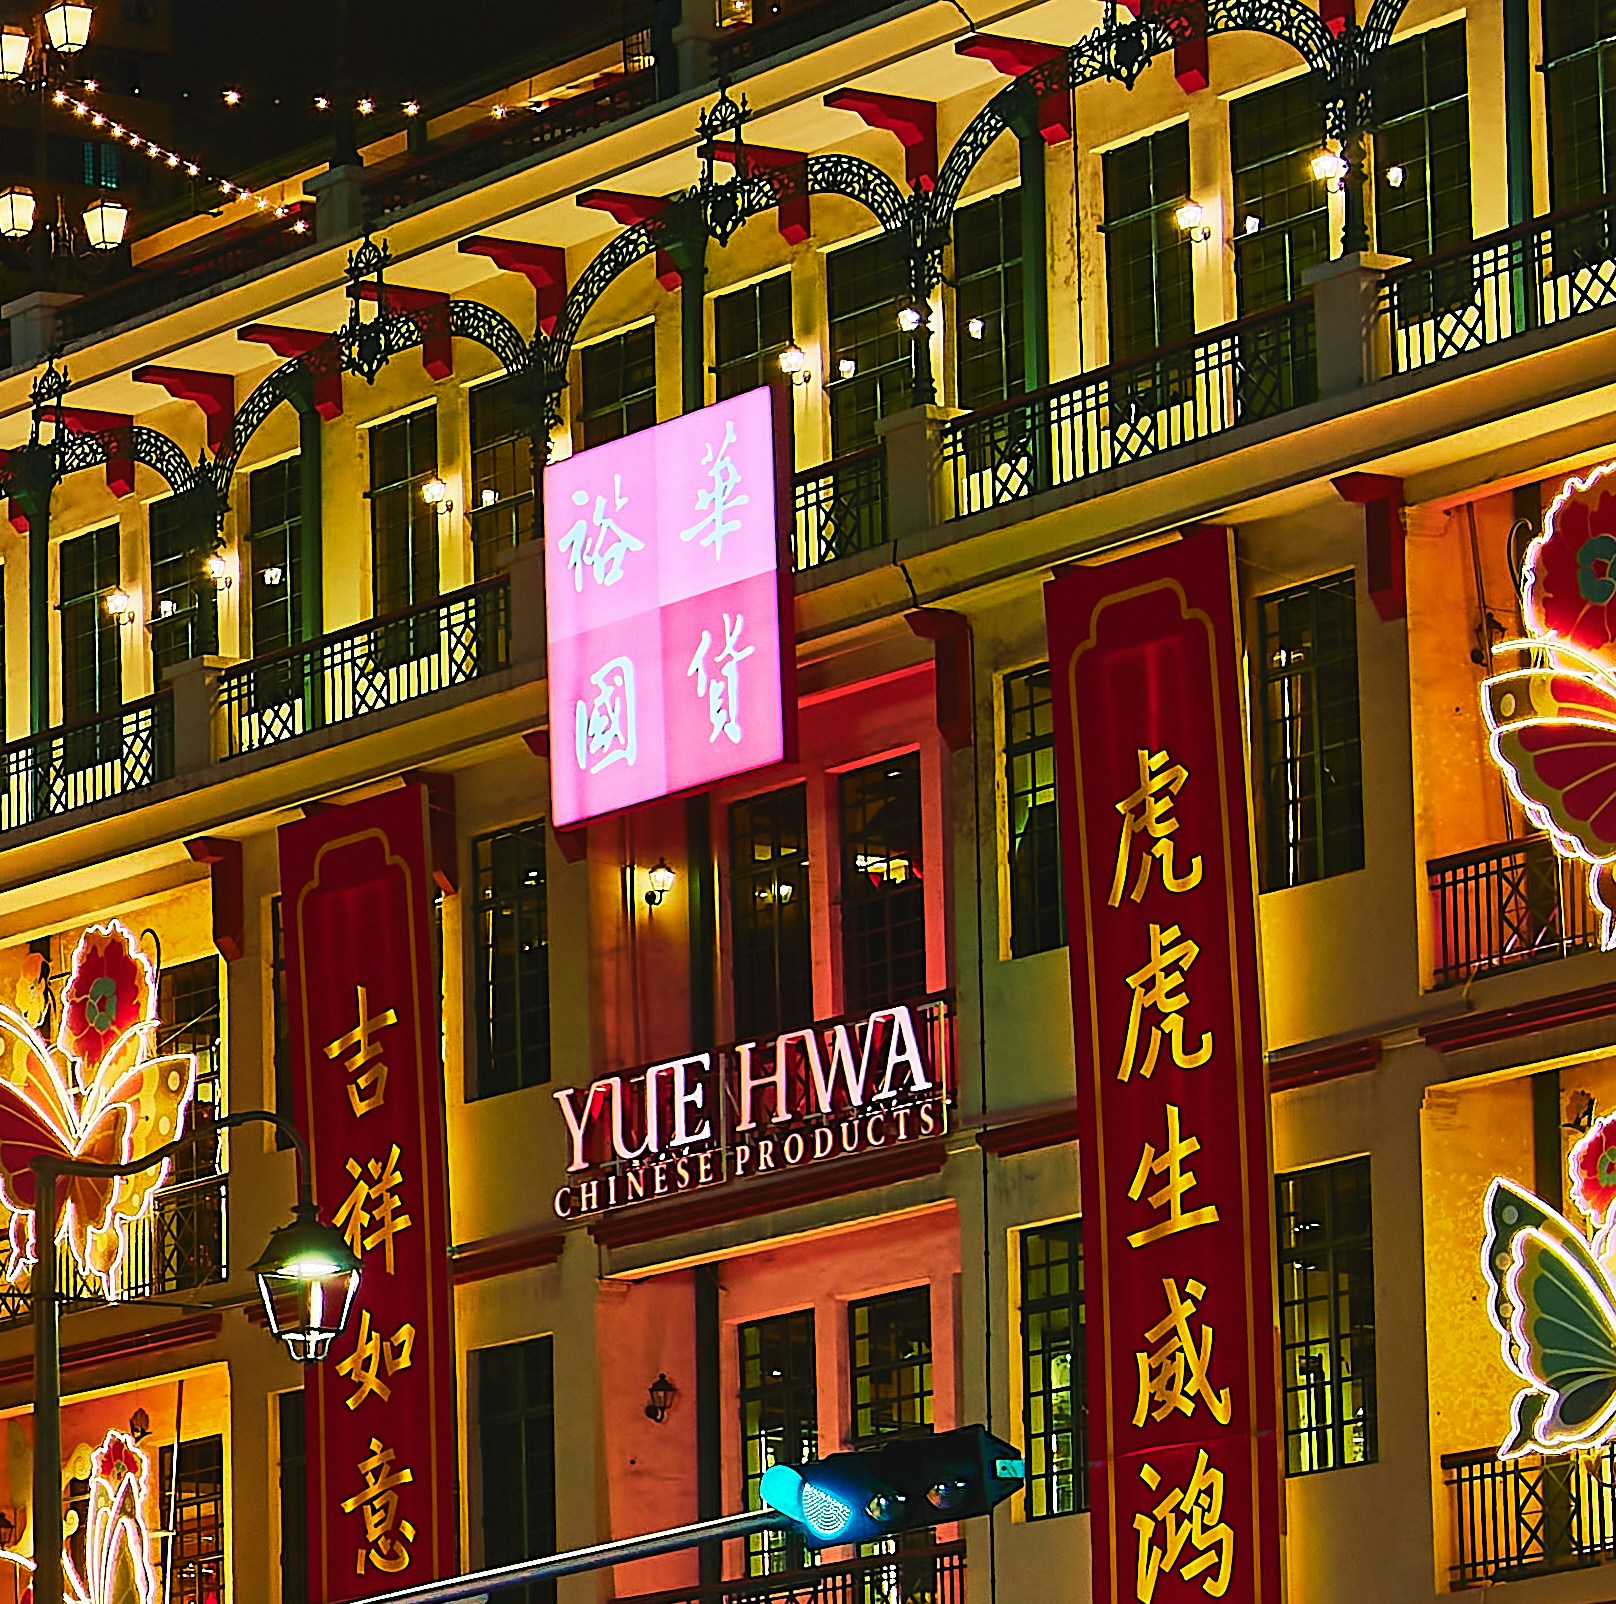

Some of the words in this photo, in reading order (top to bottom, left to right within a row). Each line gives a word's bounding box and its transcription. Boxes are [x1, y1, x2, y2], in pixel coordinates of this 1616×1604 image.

[553, 1052, 712, 1173] YUE
[735, 1005, 932, 1132] HWA
[554, 1151, 715, 1218] CHINESE
[735, 1104, 935, 1175] PRODUCTS
